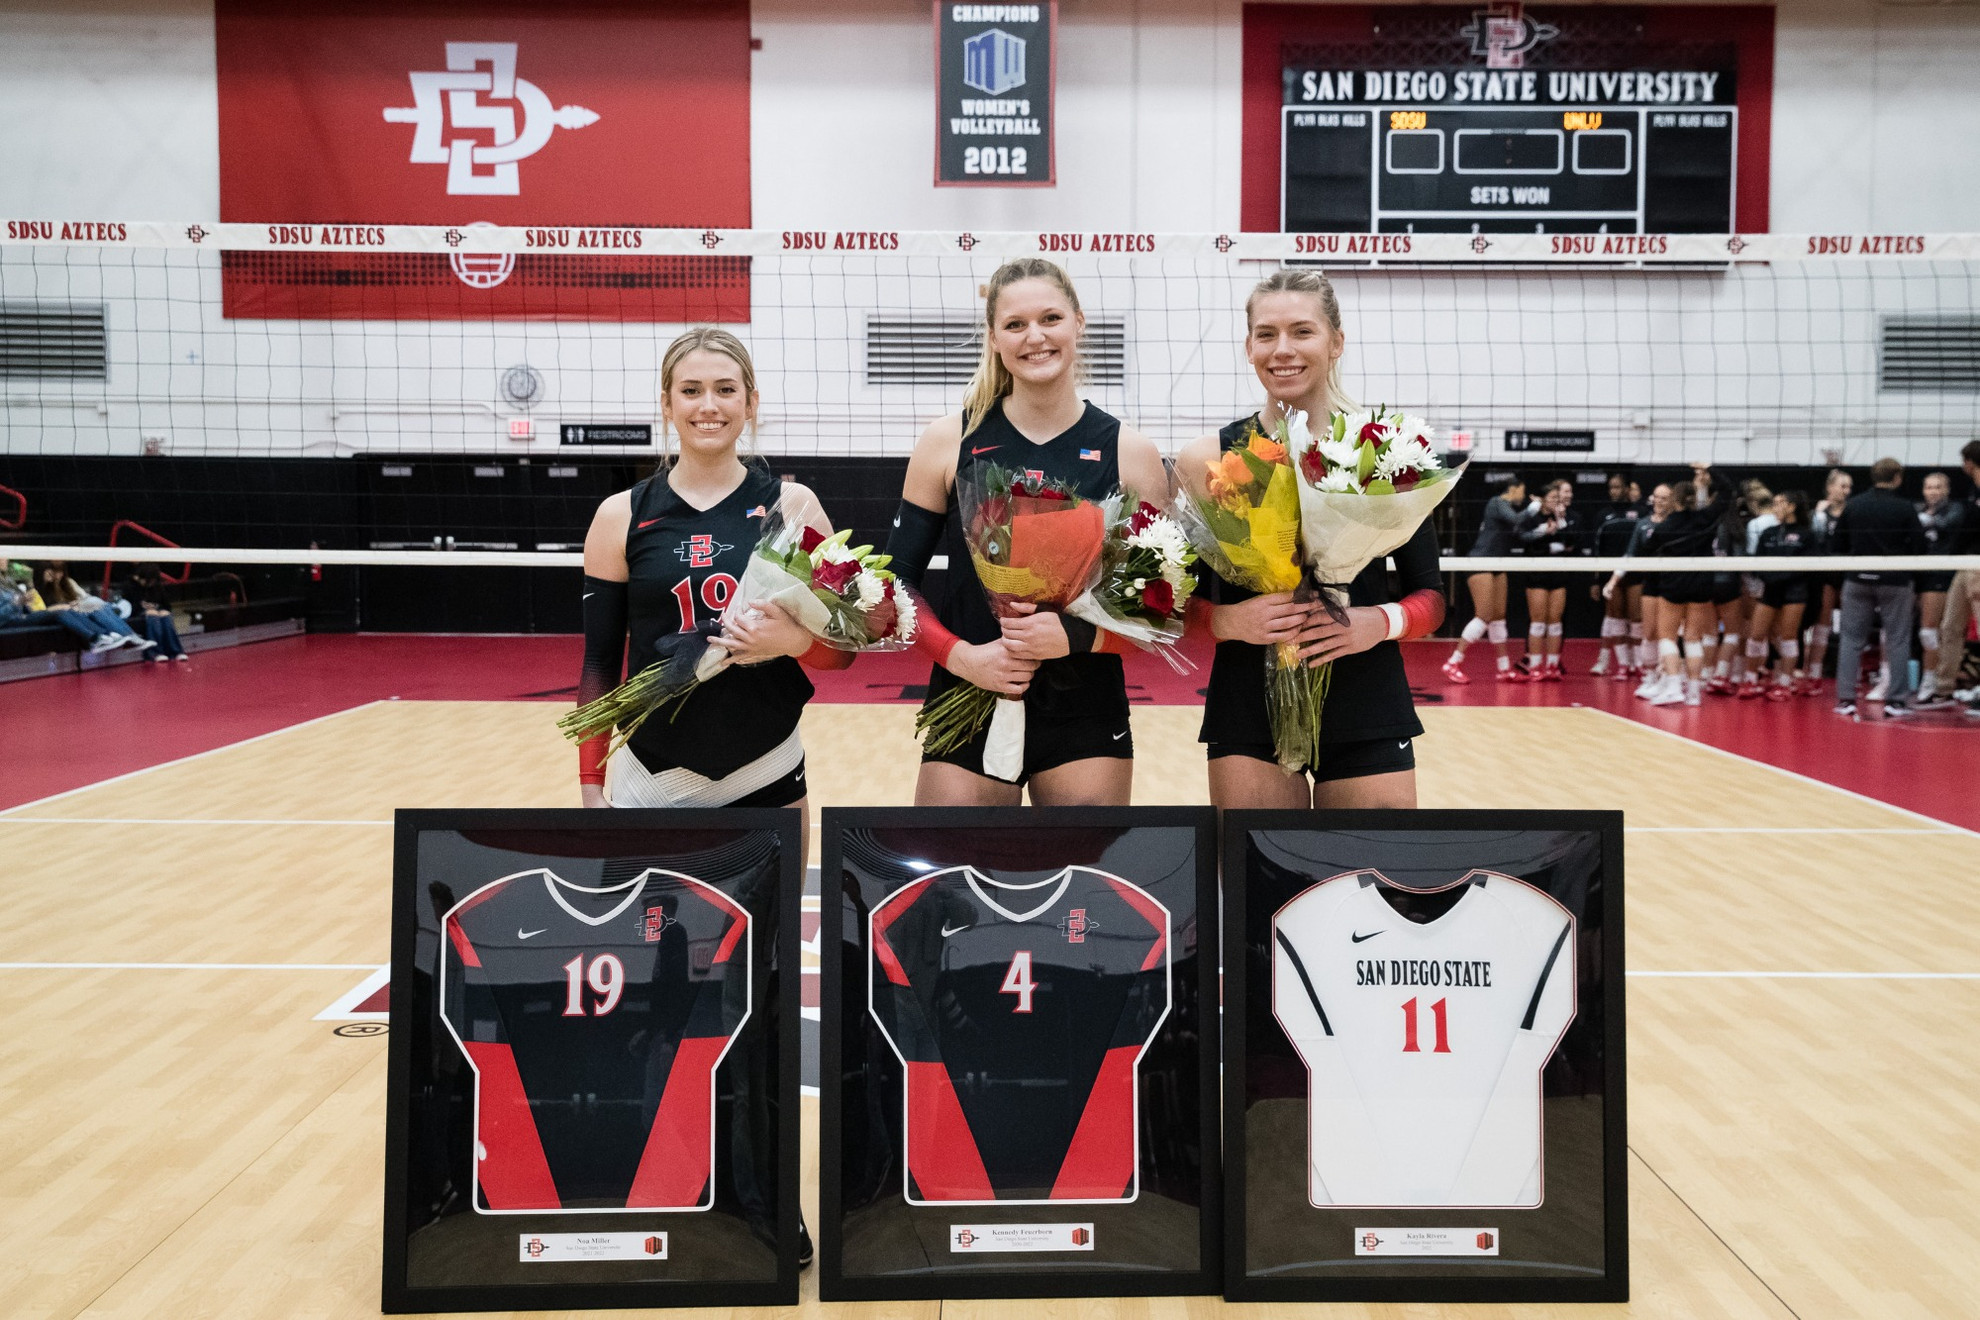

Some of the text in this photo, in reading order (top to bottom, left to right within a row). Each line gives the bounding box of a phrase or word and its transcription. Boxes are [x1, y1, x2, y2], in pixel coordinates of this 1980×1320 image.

[952, 5, 1040, 22] CHAMPIONS
[1302, 71, 1718, 103] SAN DIEGO STATE UNIVERSITY
[961, 99, 1031, 116] WOMEN'S
[950, 118, 1041, 135] VOLLEYBALL
[964, 147, 1027, 174] 2012
[1470, 186, 1550, 205] SETS WON
[8, 221, 127, 241] SDSU AZTECS
[268, 226, 385, 245] SDSU AZTECS
[525, 229, 642, 248] SDSU AZTECS
[782, 231, 899, 250] SDSU AZTECS
[1038, 233, 1155, 252] SDSU AZTECS
[1295, 235, 1411, 253] SDSU AZTECS
[1552, 236, 1667, 254] SDSU AZTECS
[1808, 236, 1924, 254] SDSU AZTECS
[670, 572, 740, 634] 19
[999, 950, 1039, 1013] 4
[1356, 960, 1492, 987] SAN DIEGO STATE
[561, 952, 625, 1017] 19
[1400, 996, 1452, 1053] 11
